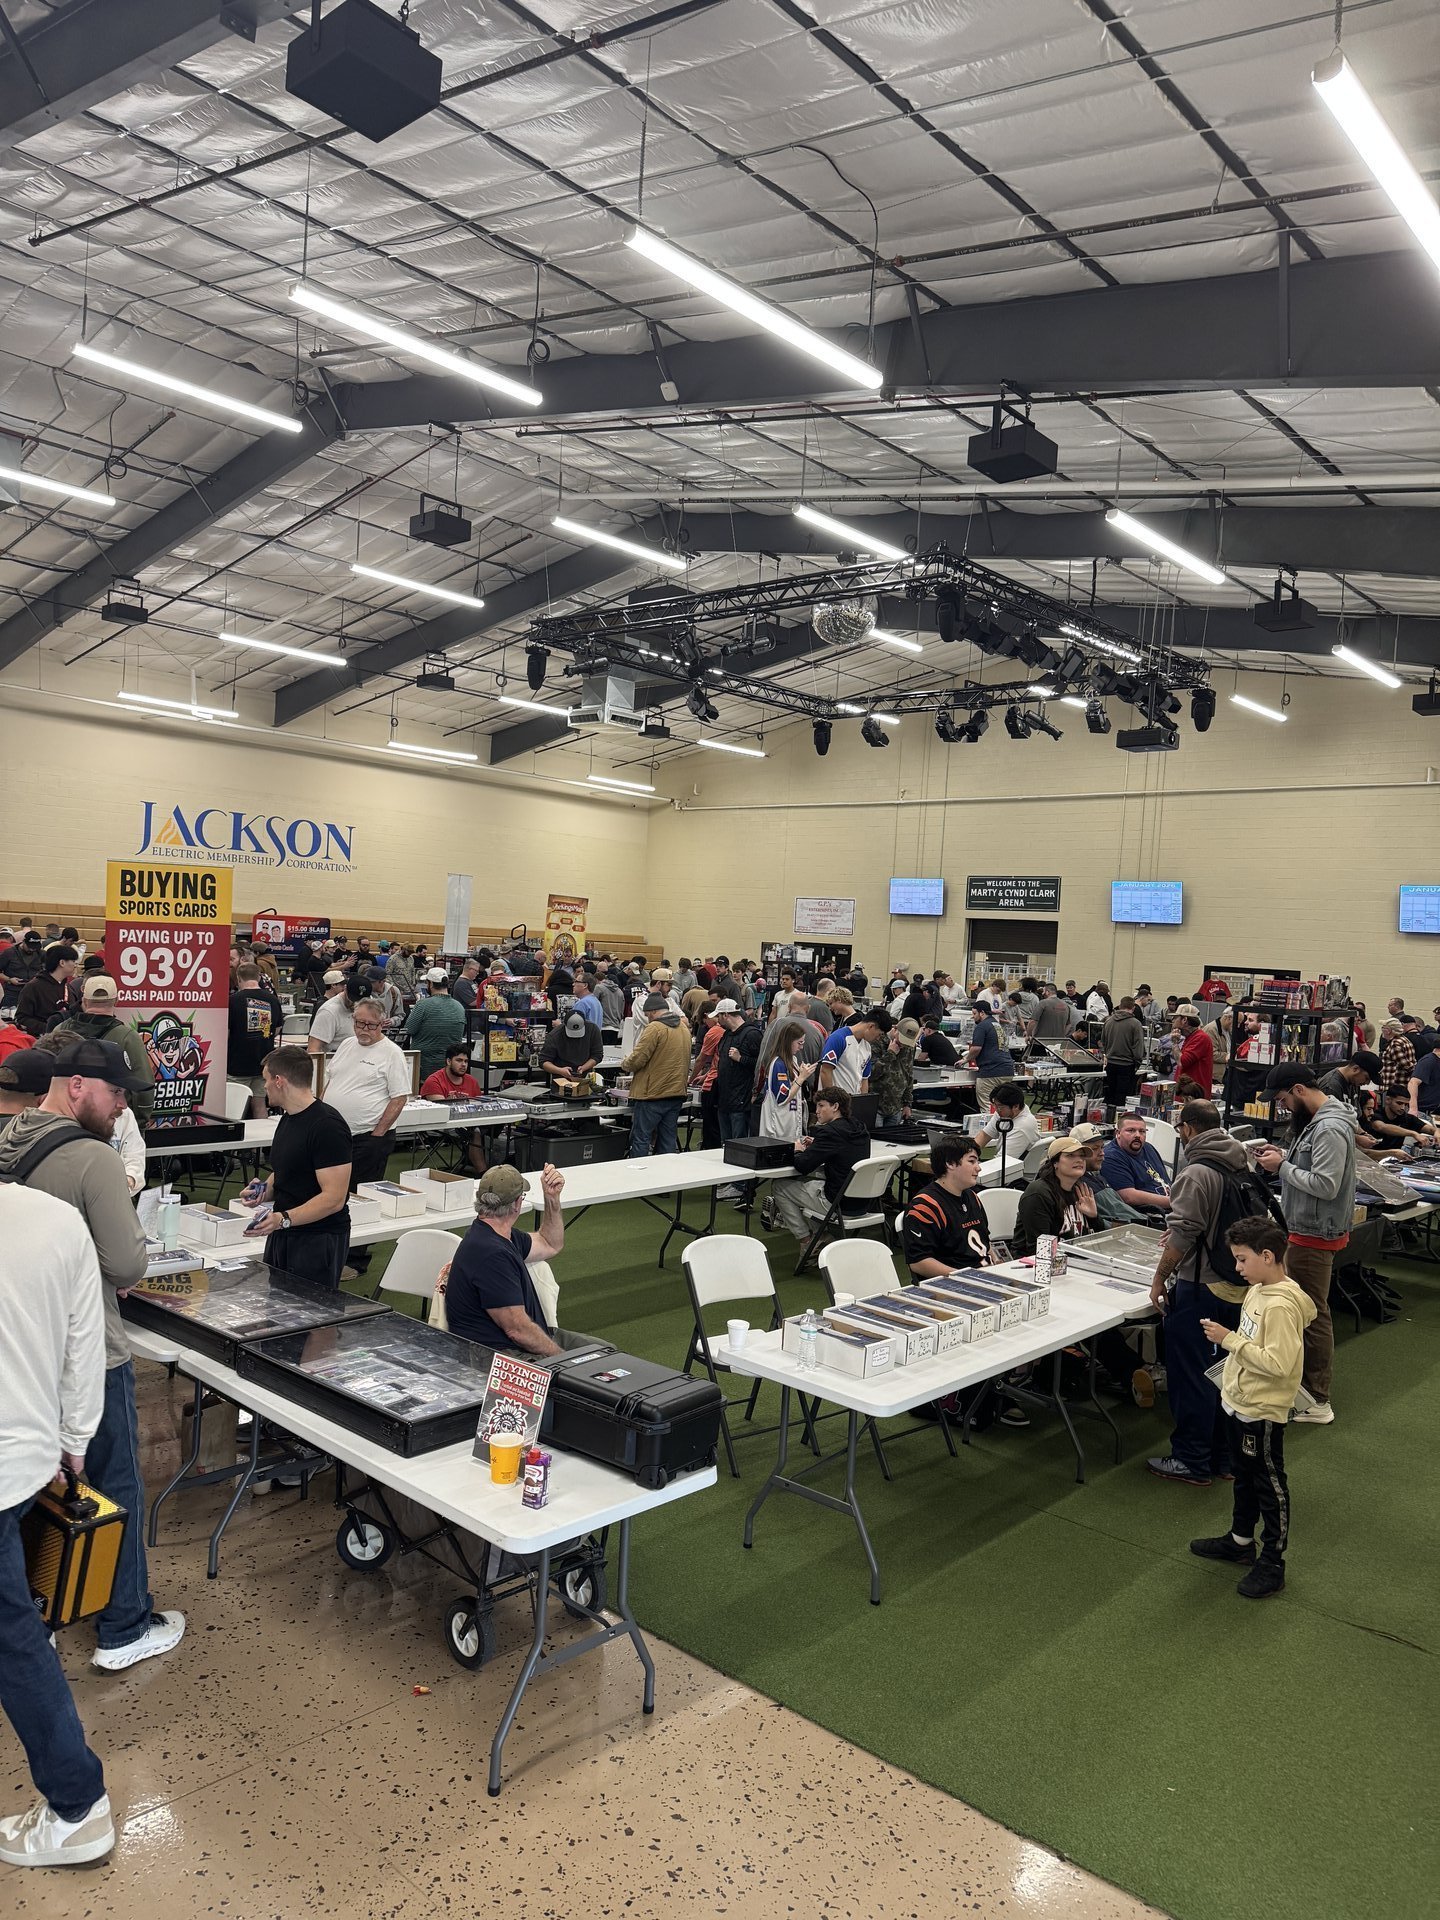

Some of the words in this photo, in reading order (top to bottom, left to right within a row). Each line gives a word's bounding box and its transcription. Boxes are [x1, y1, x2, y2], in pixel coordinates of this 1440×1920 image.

[135, 800, 356, 867] JACKSON
[152, 846, 204, 860] ELECTRIC
[206, 852, 275, 866] MEMBERSHIP
[286, 859, 351, 872] CORPORATION
[120, 869, 216, 900] BUYING
[970, 888, 997, 897] MARTY
[1004, 889, 1027, 897] CYNDI
[1029, 889, 1056, 898] CLARK
[119, 900, 170, 917] SPORTS
[174, 902, 217, 918] CARDS
[998, 899, 1024, 907] ARENA
[119, 929, 170, 944] PAYING
[174, 931, 193, 945] UP
[196, 932, 214, 945] TO
[120, 946, 213, 987] 93%
[117, 990, 146, 1001] CASH
[150, 990, 175, 1001] PAID
[178, 991, 212, 1002] TODAY
[164, 1098, 190, 1108] CARDS
[148, 1284, 193, 1294] CARDS
[494, 1358, 548, 1385] BUYING!!!
[491, 1368, 546, 1396] BUYING!!!
